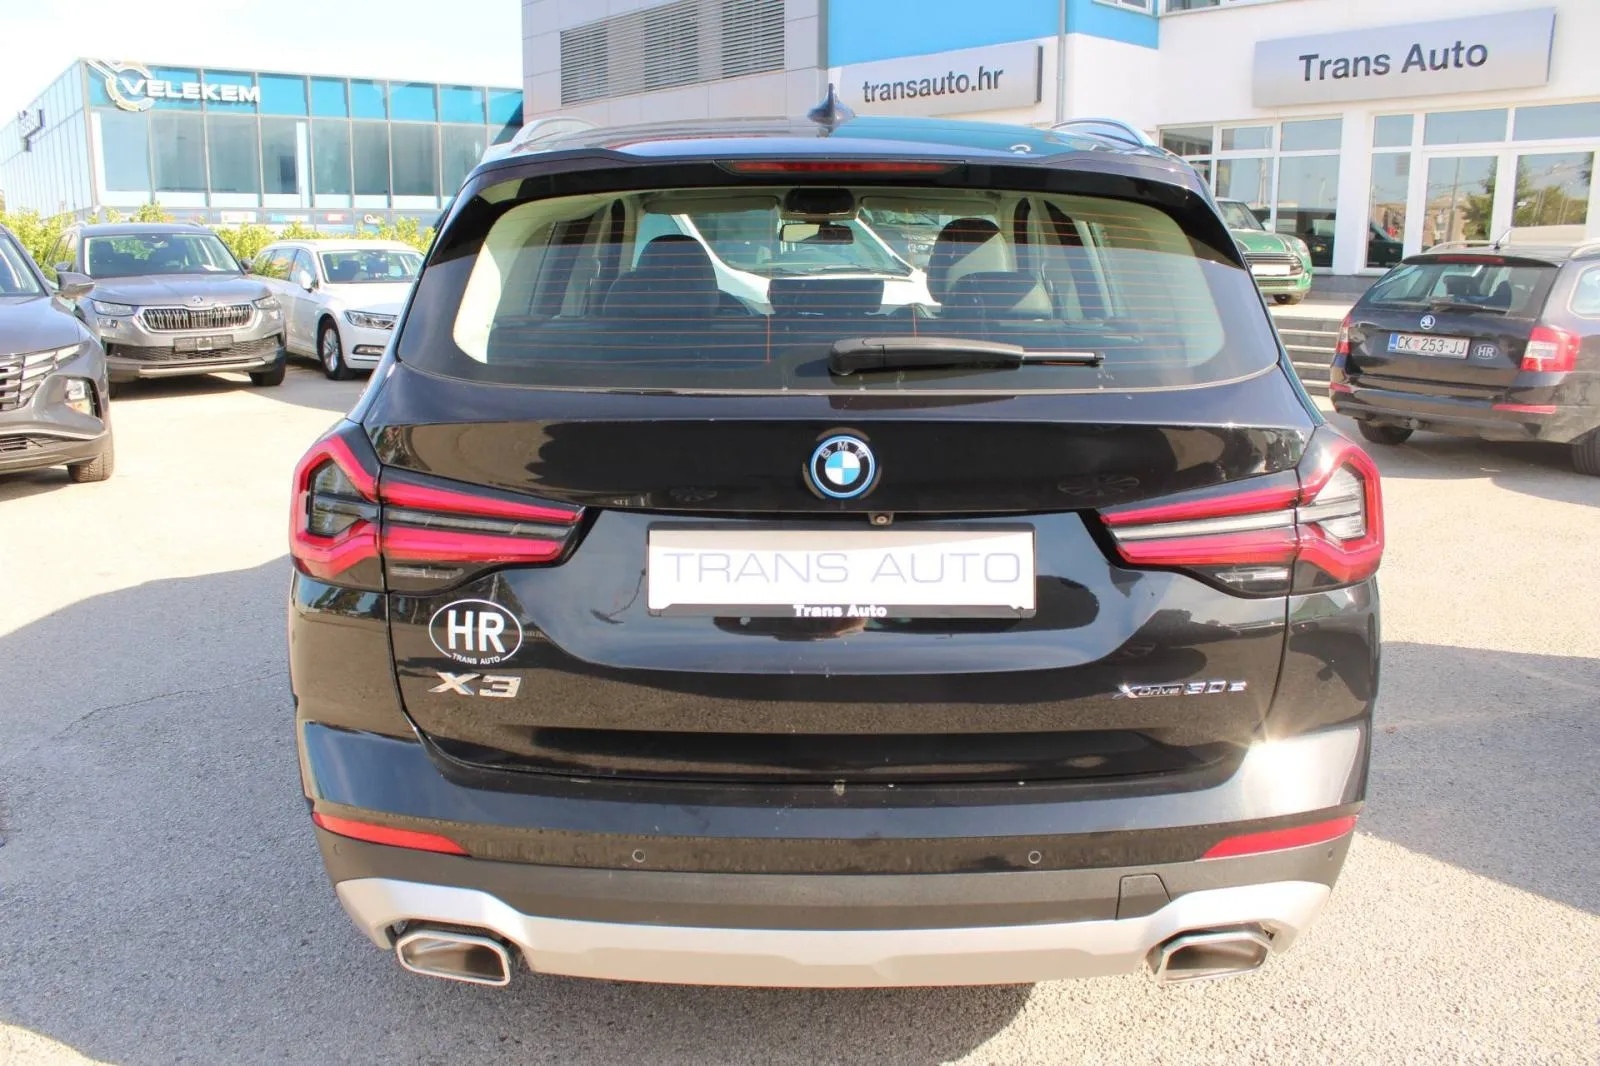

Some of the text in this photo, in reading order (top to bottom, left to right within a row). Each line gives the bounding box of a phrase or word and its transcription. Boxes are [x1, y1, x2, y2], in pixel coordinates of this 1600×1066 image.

[1299, 40, 1488, 82] Trans Auto
[120, 77, 261, 103] VELEKEM
[862, 65, 1003, 103] transauto.hr
[1477, 346, 1494, 357] HR
[819, 440, 868, 460] BMW
[663, 552, 1021, 583] TRANS AUTO
[793, 604, 888, 617] Trans Auto
[447, 609, 506, 653] HR
[452, 652, 501, 665] TRANS AUTO
[427, 671, 522, 698] X3
